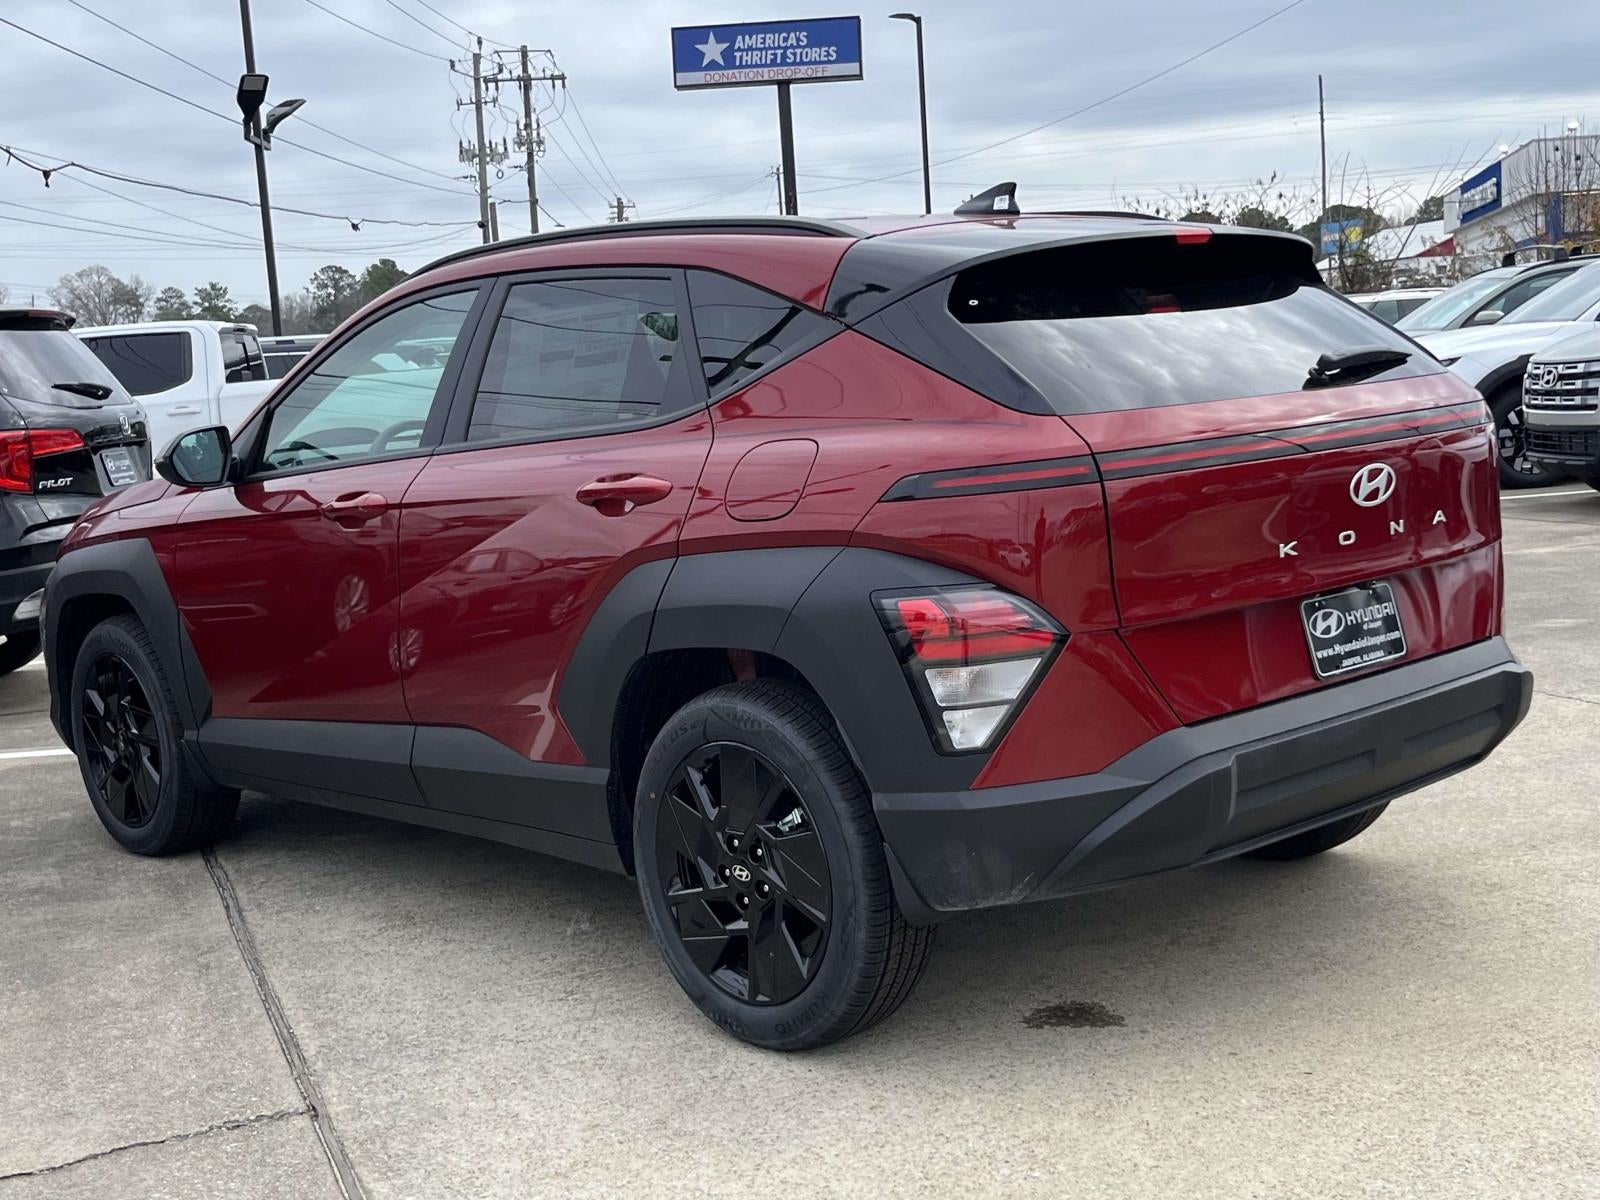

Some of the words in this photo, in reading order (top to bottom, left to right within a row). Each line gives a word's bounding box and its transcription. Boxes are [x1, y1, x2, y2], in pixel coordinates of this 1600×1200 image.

[734, 31, 808, 50] AMERICA'S
[734, 49, 784, 66] THRIFT
[786, 46, 838, 63] STORES
[704, 69, 765, 83] DONATION
[767, 66, 829, 80] DROP-OFF
[38, 477, 74, 489] PILOT
[1345, 602, 1394, 625] HYUNDAI
